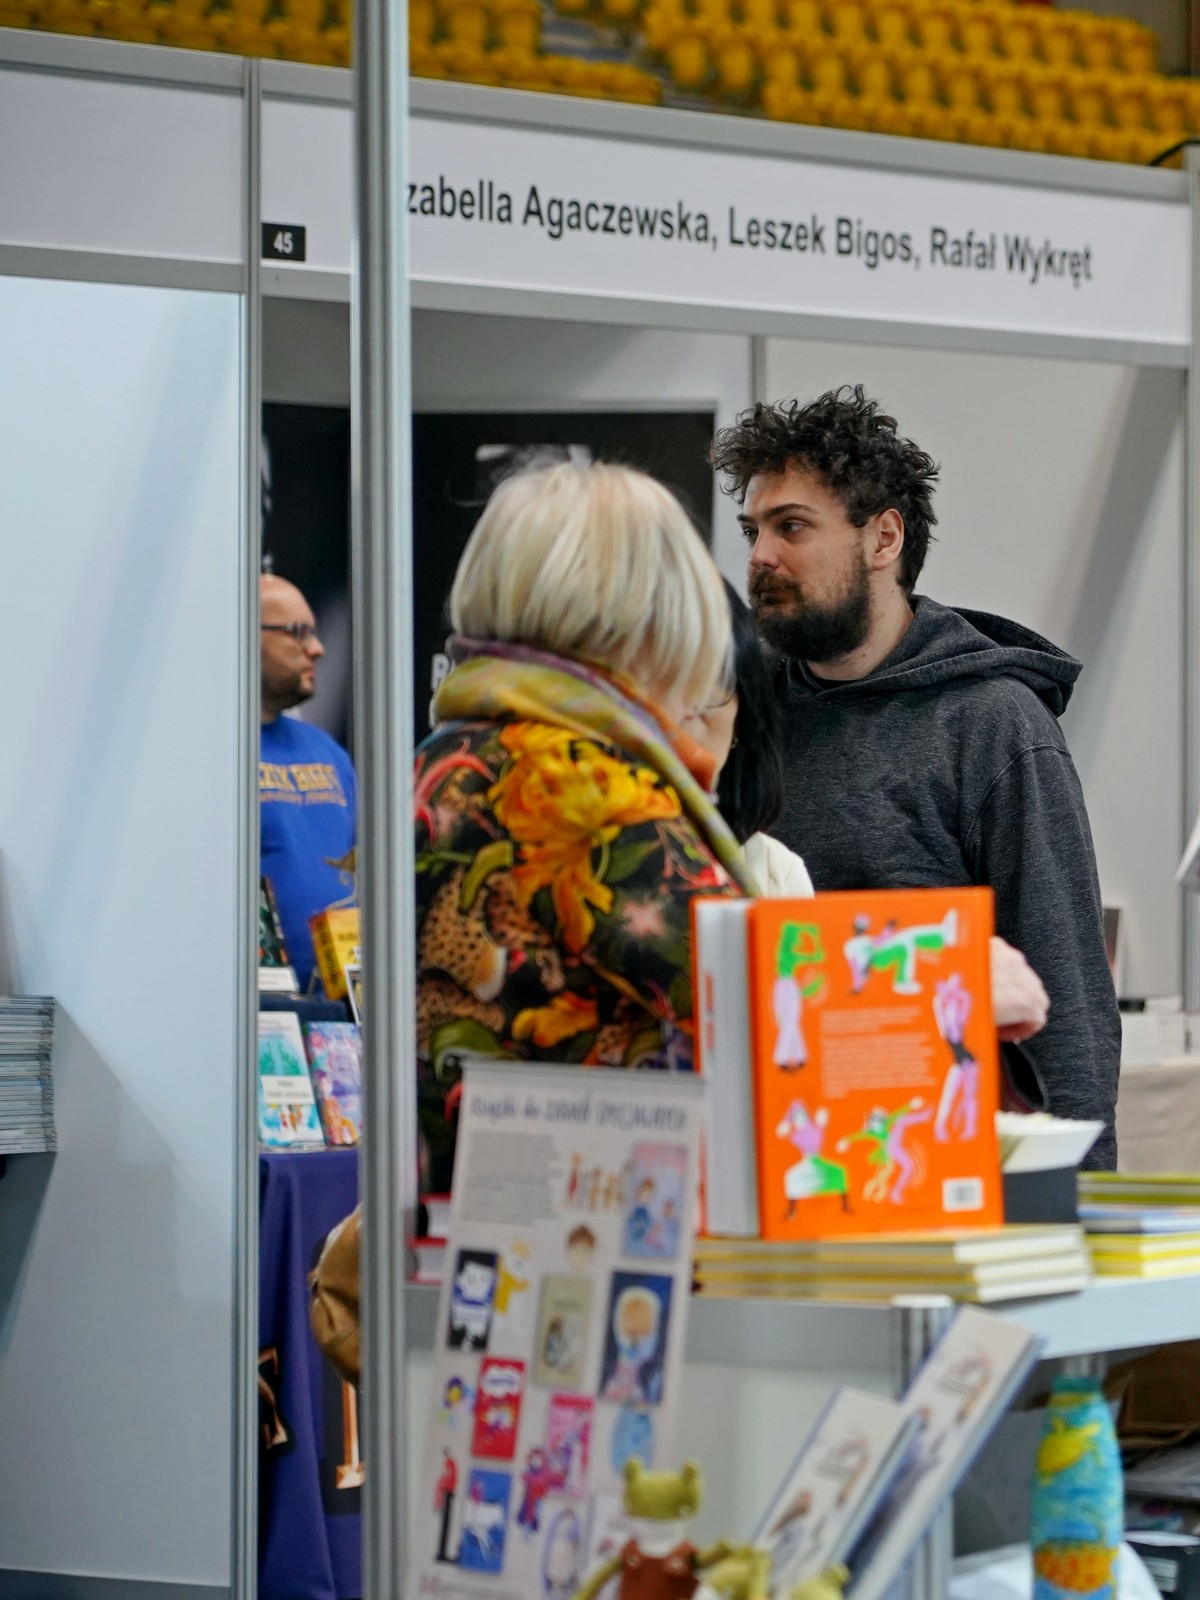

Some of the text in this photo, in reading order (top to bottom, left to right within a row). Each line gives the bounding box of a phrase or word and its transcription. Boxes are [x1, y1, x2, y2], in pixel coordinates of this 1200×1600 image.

[273, 230, 294, 254] 45
[521, 183, 718, 251] Agaczewska,
[728, 206, 826, 254] Leszek
[835, 215, 921, 270] Bigos,
[930, 226, 997, 271] Rafał
[1003, 233, 1093, 289] Wykręt
